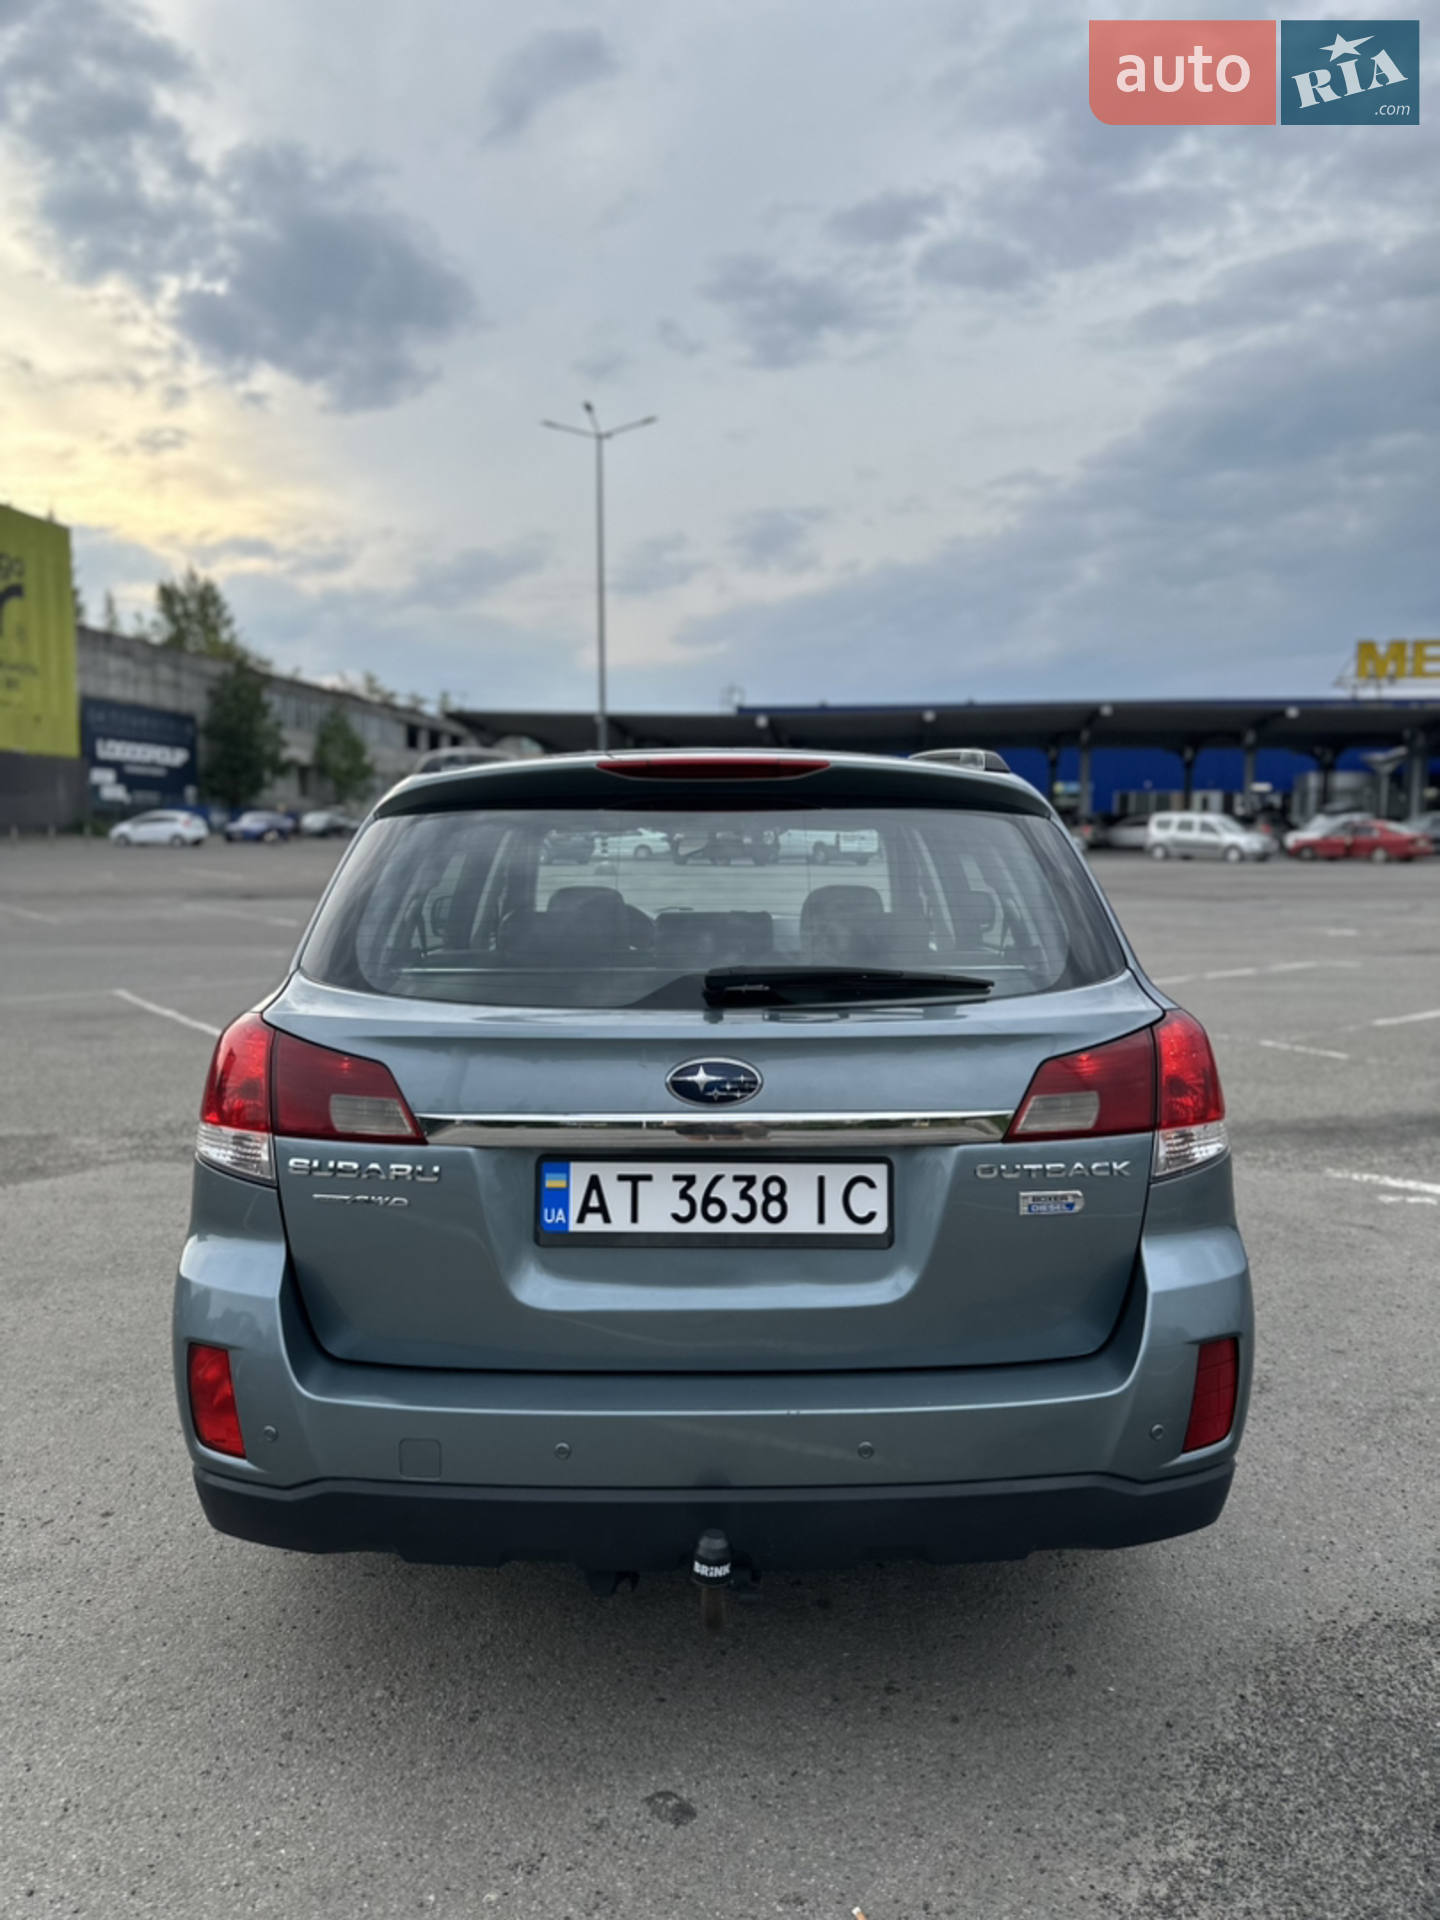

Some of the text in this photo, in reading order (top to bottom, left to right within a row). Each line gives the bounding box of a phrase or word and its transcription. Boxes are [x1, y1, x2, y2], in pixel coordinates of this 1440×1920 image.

[288, 1157, 440, 1182] SUBARU
[976, 1160, 1131, 1179] OUTBACK
[576, 1174, 878, 1225] AT 3638 IC
[544, 1208, 566, 1224] UA
